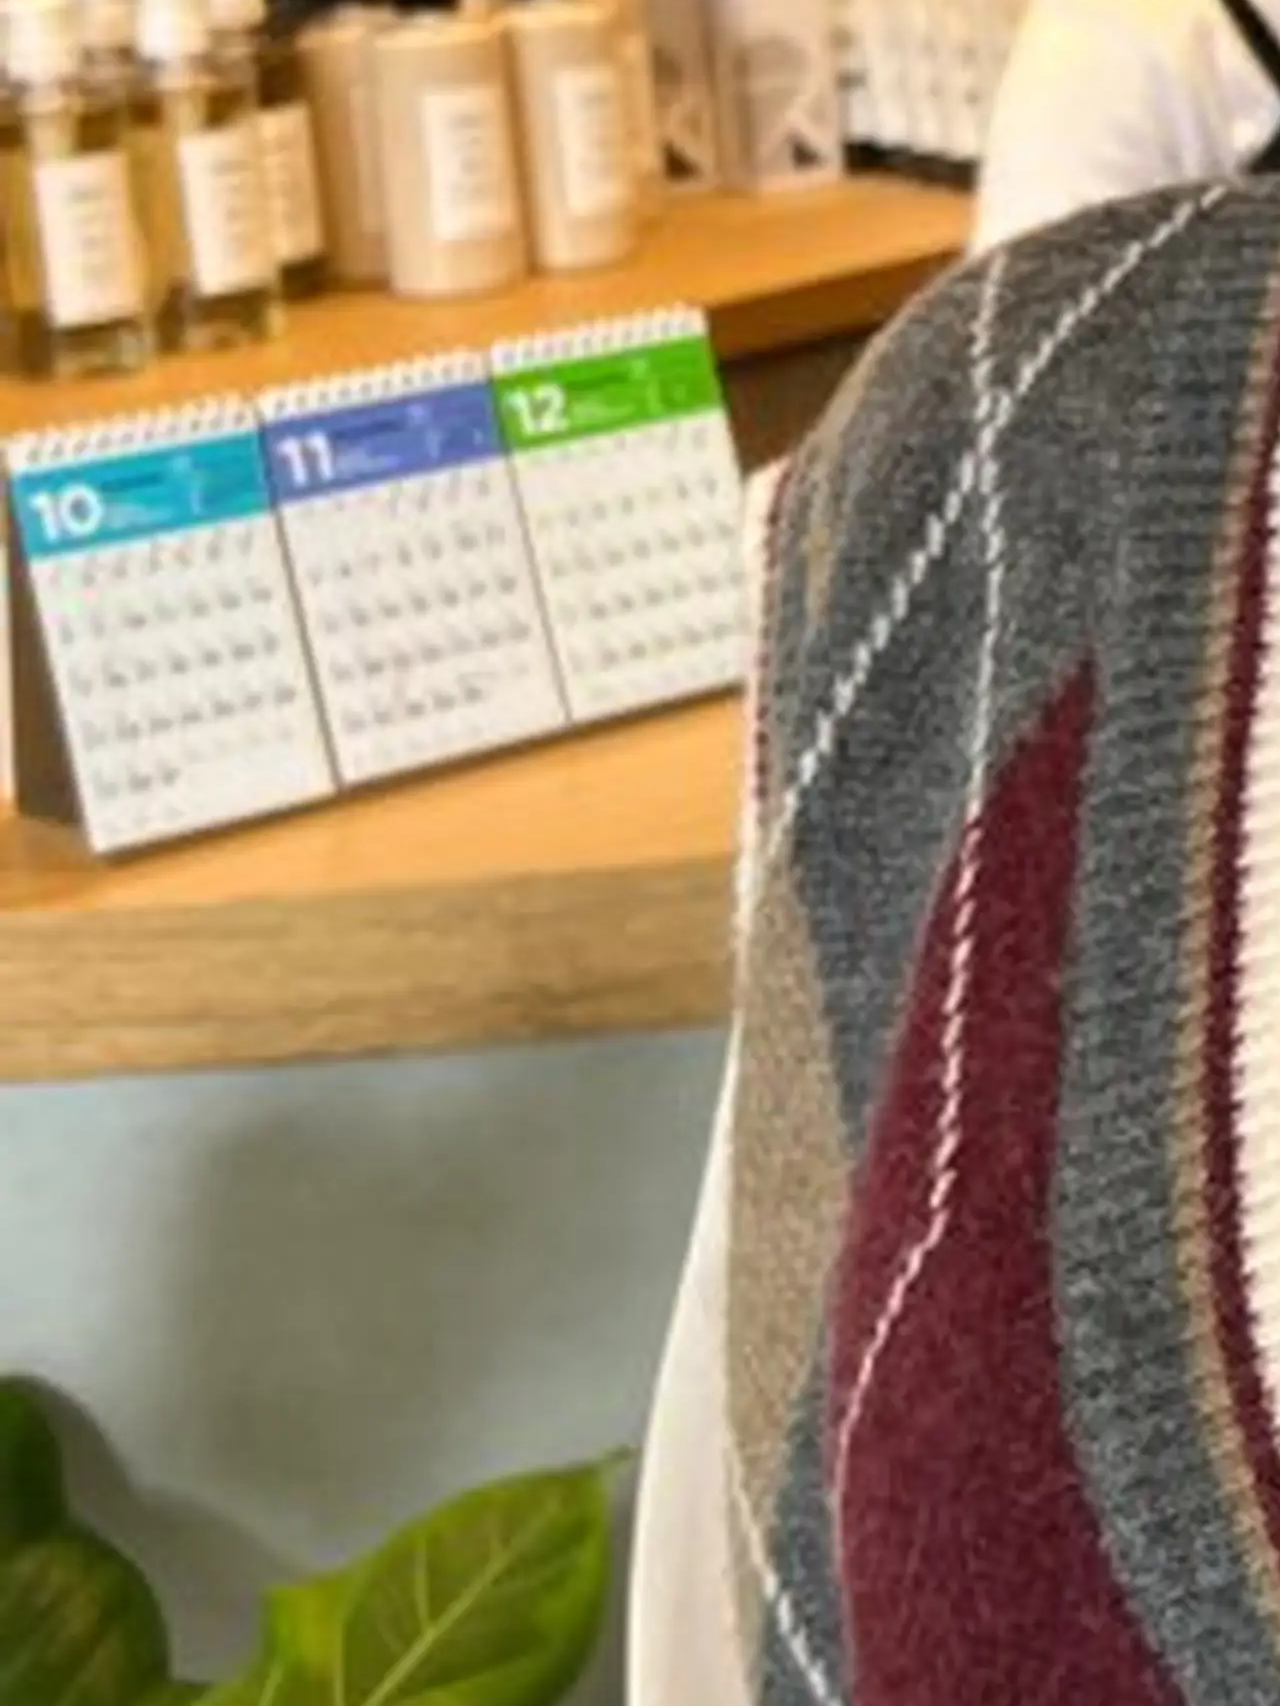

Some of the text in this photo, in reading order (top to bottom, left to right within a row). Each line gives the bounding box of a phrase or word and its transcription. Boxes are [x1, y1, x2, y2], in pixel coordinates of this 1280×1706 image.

[508, 382, 569, 437] 12
[276, 430, 335, 487] 11
[28, 483, 103, 542] 10
